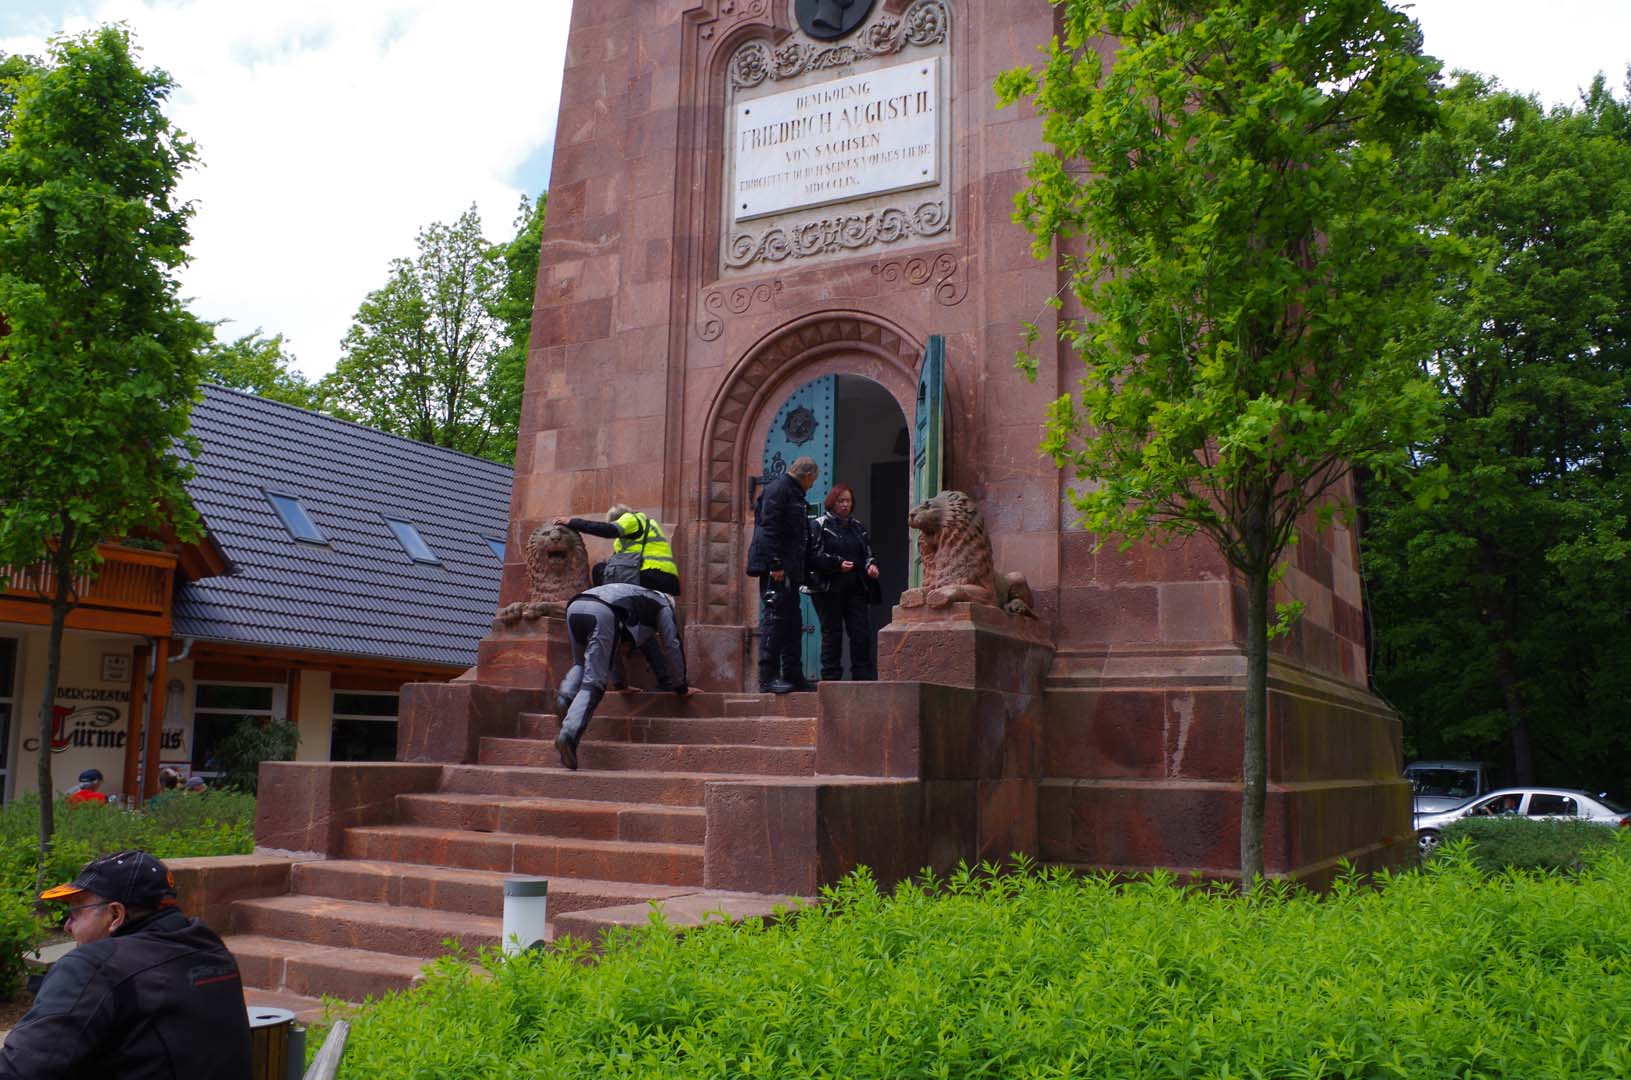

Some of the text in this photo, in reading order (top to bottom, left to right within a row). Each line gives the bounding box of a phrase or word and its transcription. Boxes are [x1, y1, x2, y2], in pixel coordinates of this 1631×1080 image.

[797, 81, 871, 111] DEM KOENIG
[741, 111, 832, 153] FRIEDRICH
[838, 94, 912, 131] AUGUST
[785, 132, 880, 163] VON SACHSEN
